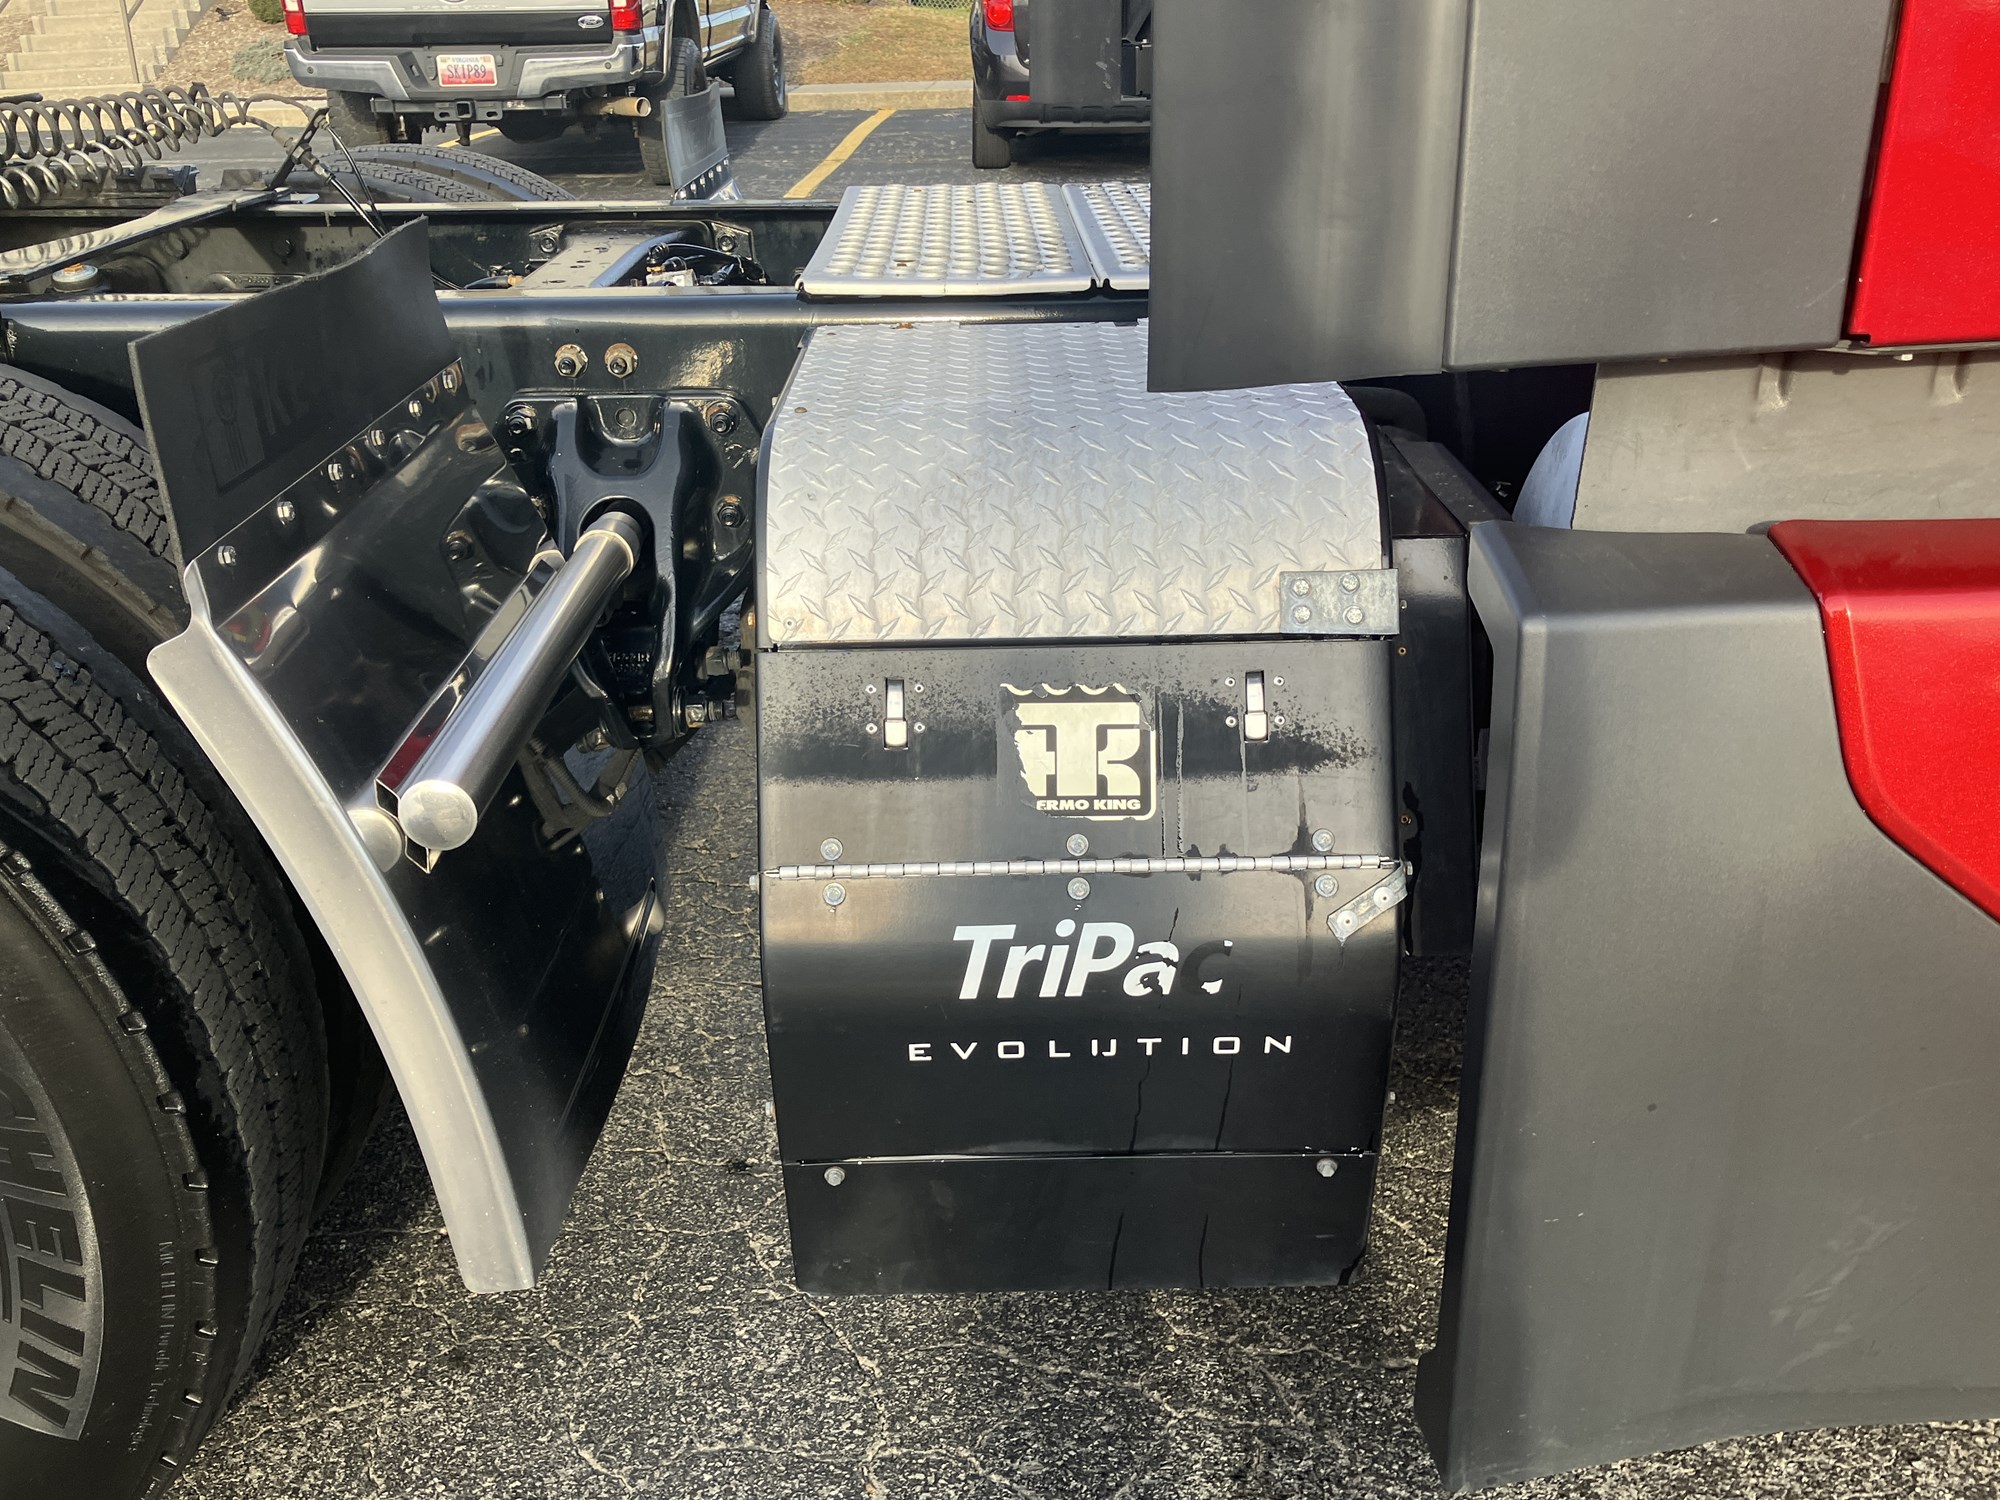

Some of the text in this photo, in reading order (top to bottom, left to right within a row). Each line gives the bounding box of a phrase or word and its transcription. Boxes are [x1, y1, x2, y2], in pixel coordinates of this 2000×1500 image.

[446, 64, 487, 79] SKIP89
[1093, 799, 1141, 811] KING
[908, 1035, 1292, 1062] EVOLUTION
